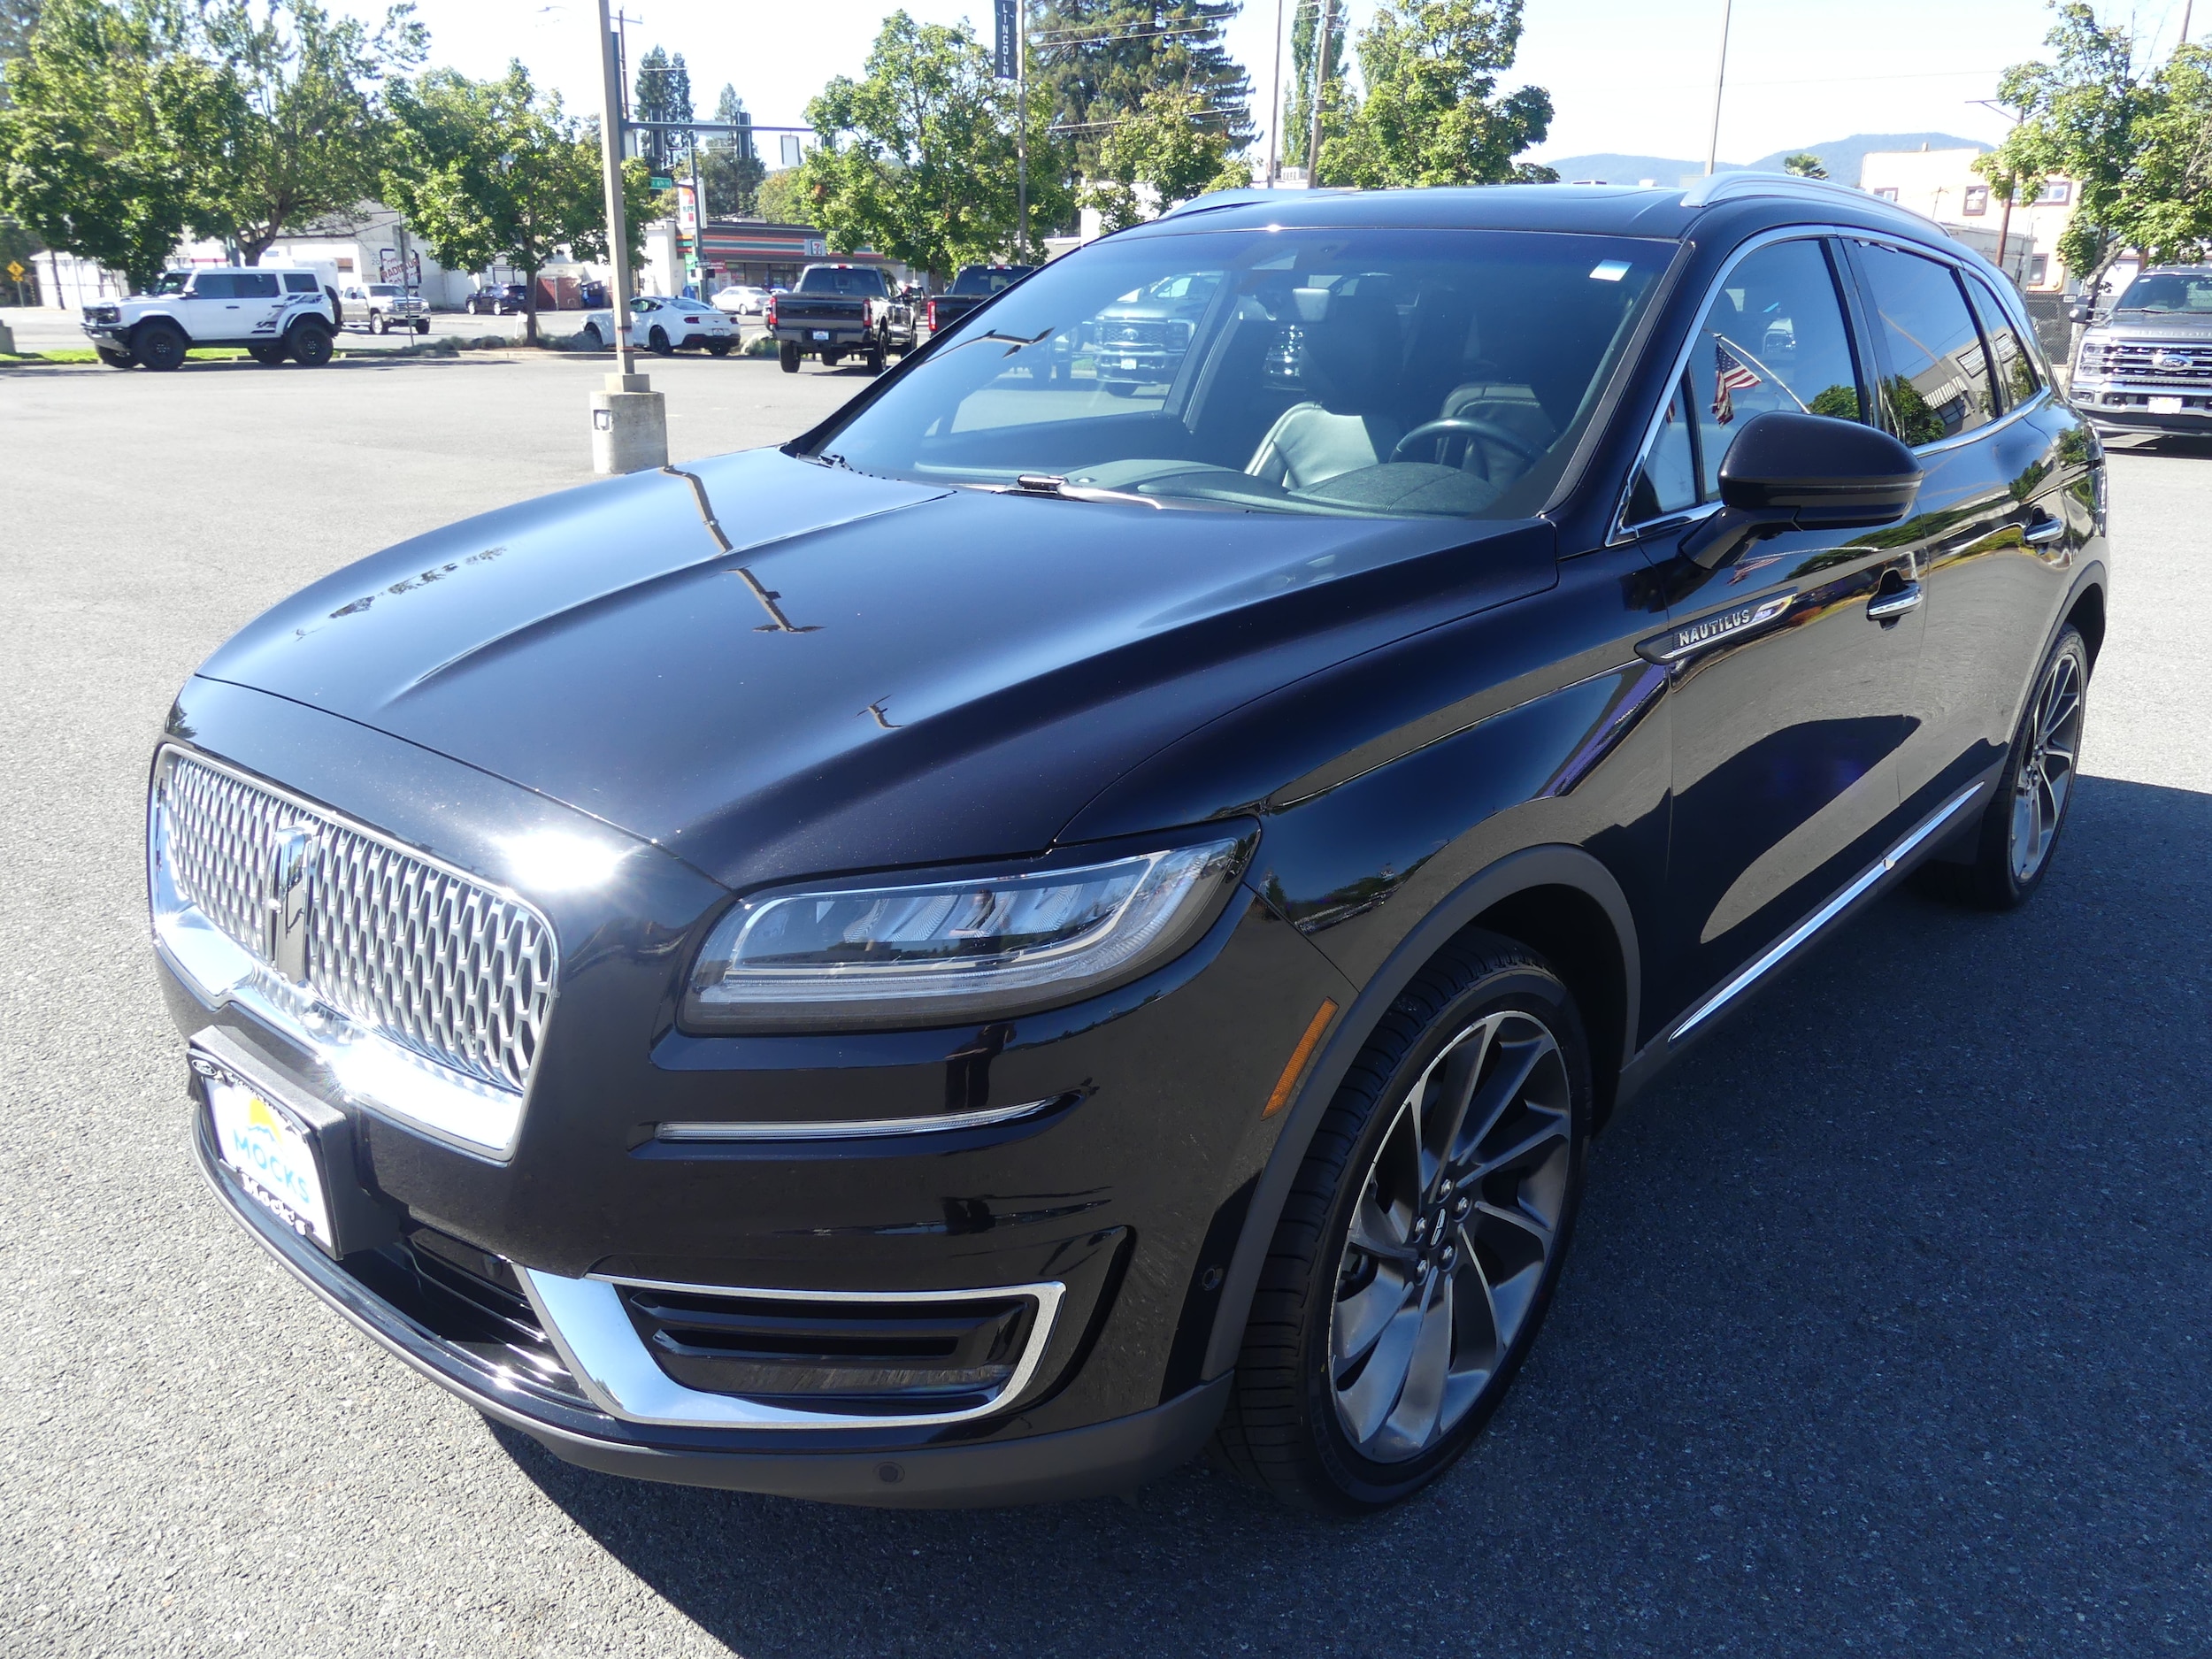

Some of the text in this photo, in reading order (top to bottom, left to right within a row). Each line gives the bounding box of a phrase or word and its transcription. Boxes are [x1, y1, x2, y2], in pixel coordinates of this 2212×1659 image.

[2162, 358, 2183, 367] Ford
[1679, 609, 1750, 647] NAUTILUS
[233, 1128, 310, 1204] MOCKS
